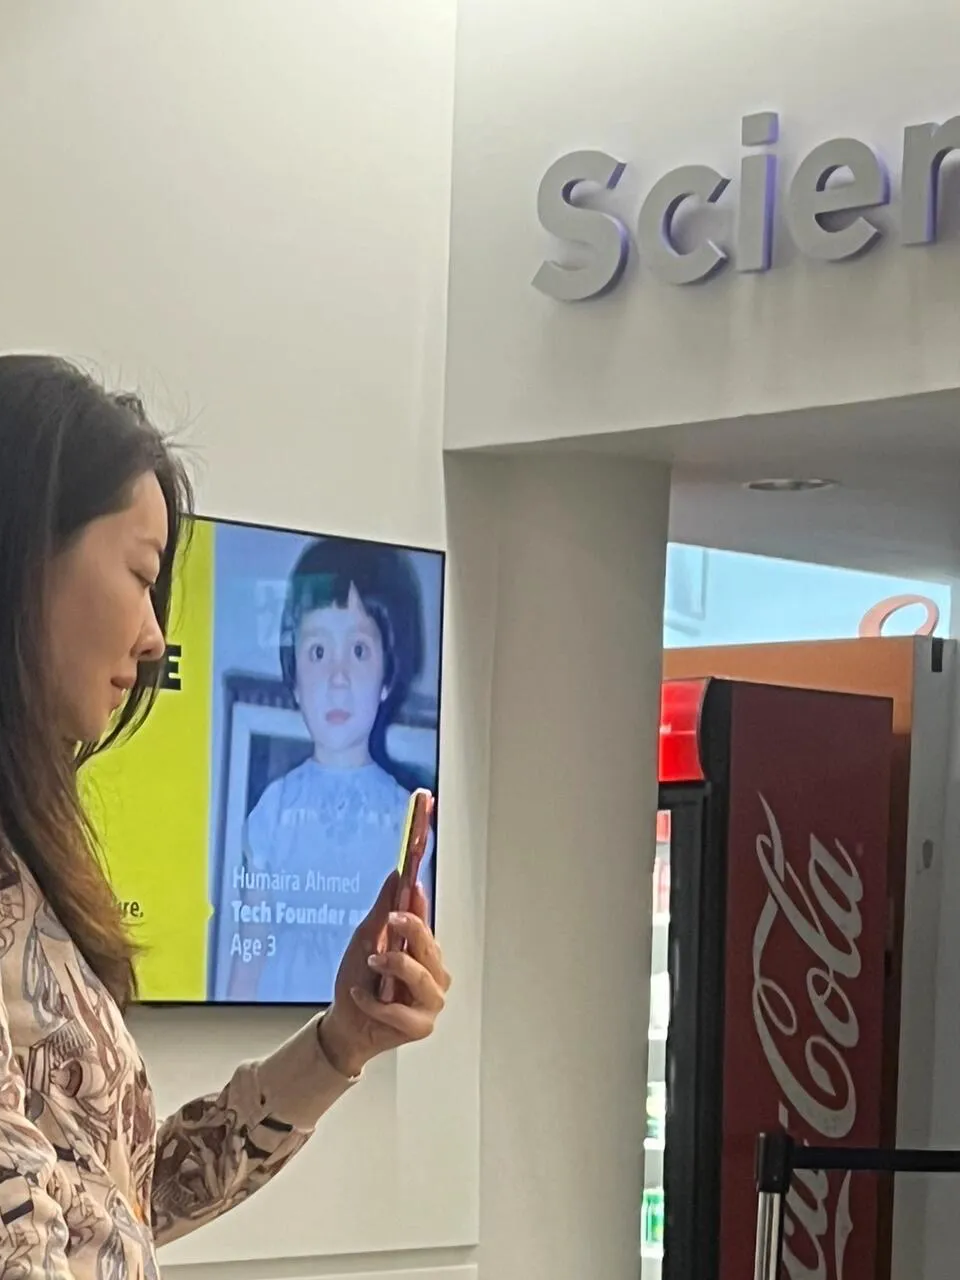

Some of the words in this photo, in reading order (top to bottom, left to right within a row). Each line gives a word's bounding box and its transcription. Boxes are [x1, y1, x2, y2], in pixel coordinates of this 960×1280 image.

[233, 866, 300, 891] Humaira
[305, 870, 360, 893] Ahmed
[233, 901, 272, 924] Tech
[276, 903, 345, 926] Founder
[230, 934, 262, 962] Age
[268, 935, 276, 956] 3
